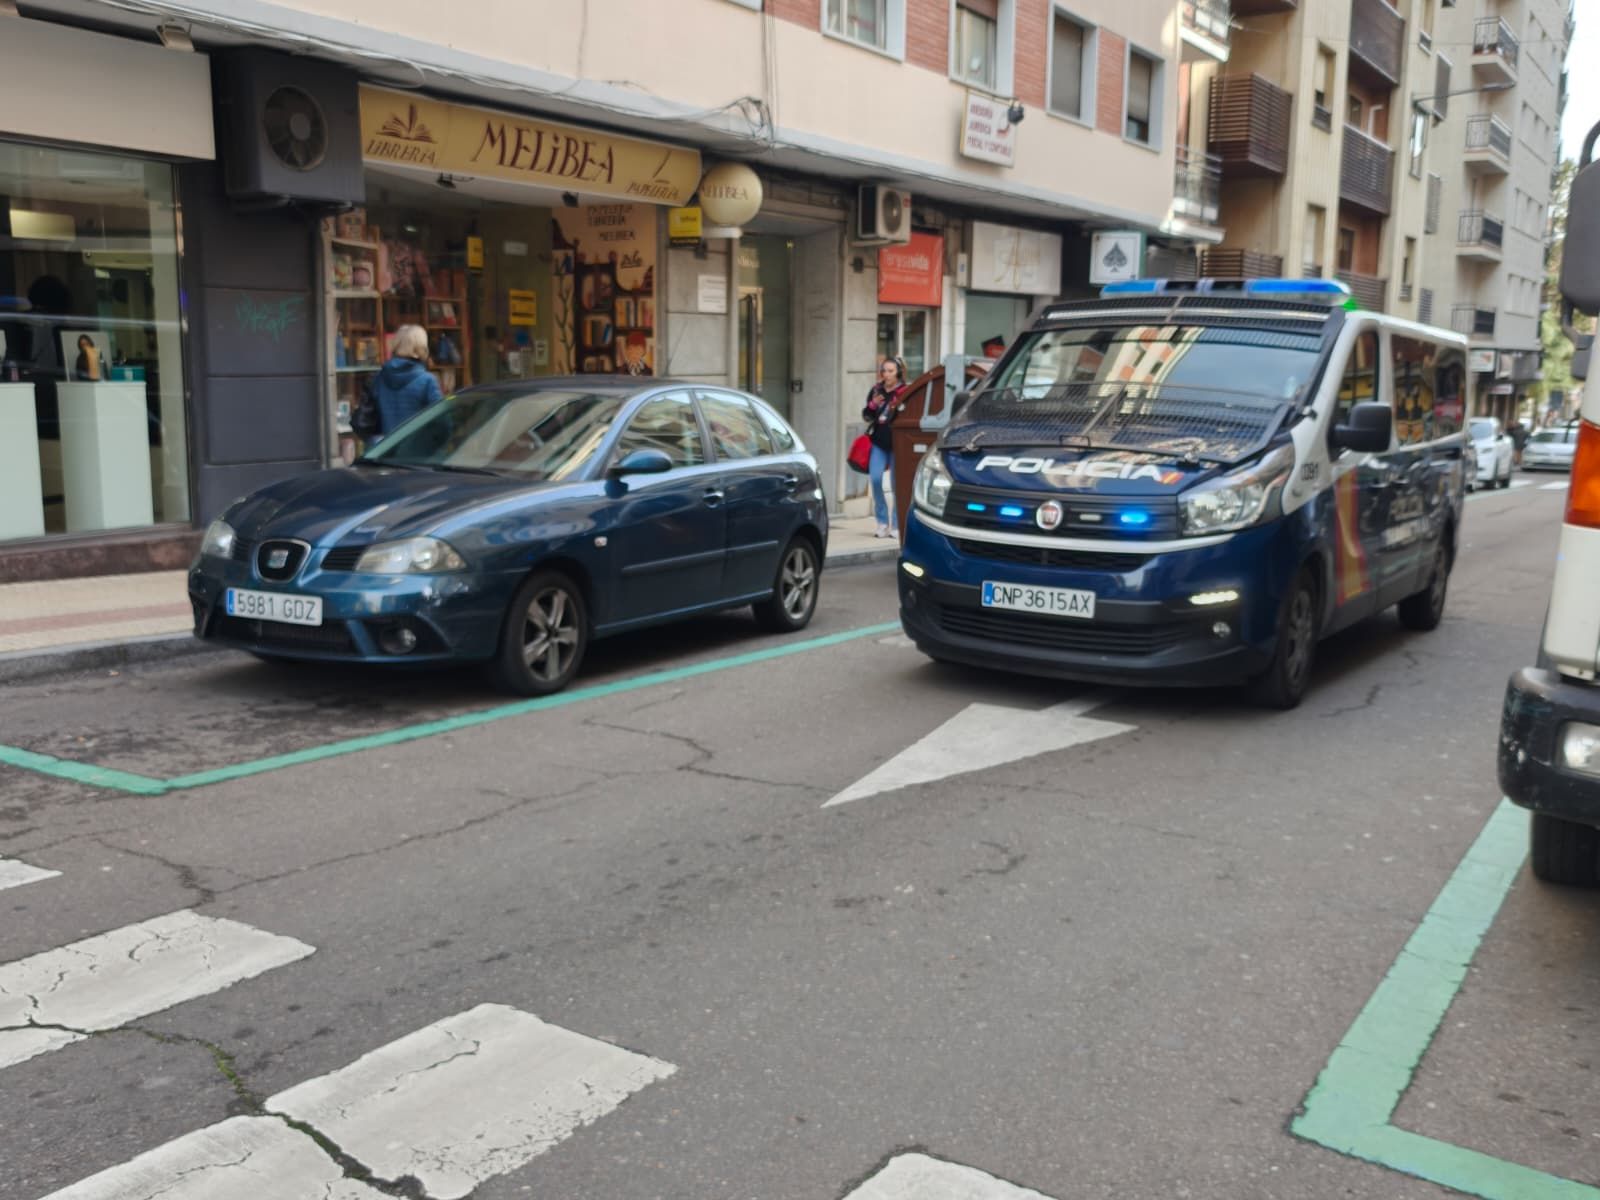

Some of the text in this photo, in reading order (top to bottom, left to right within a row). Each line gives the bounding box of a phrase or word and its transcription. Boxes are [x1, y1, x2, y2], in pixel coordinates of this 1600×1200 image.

[238, 593, 316, 621] 5981 GDZ
[992, 586, 1090, 613] CNP3615AX
